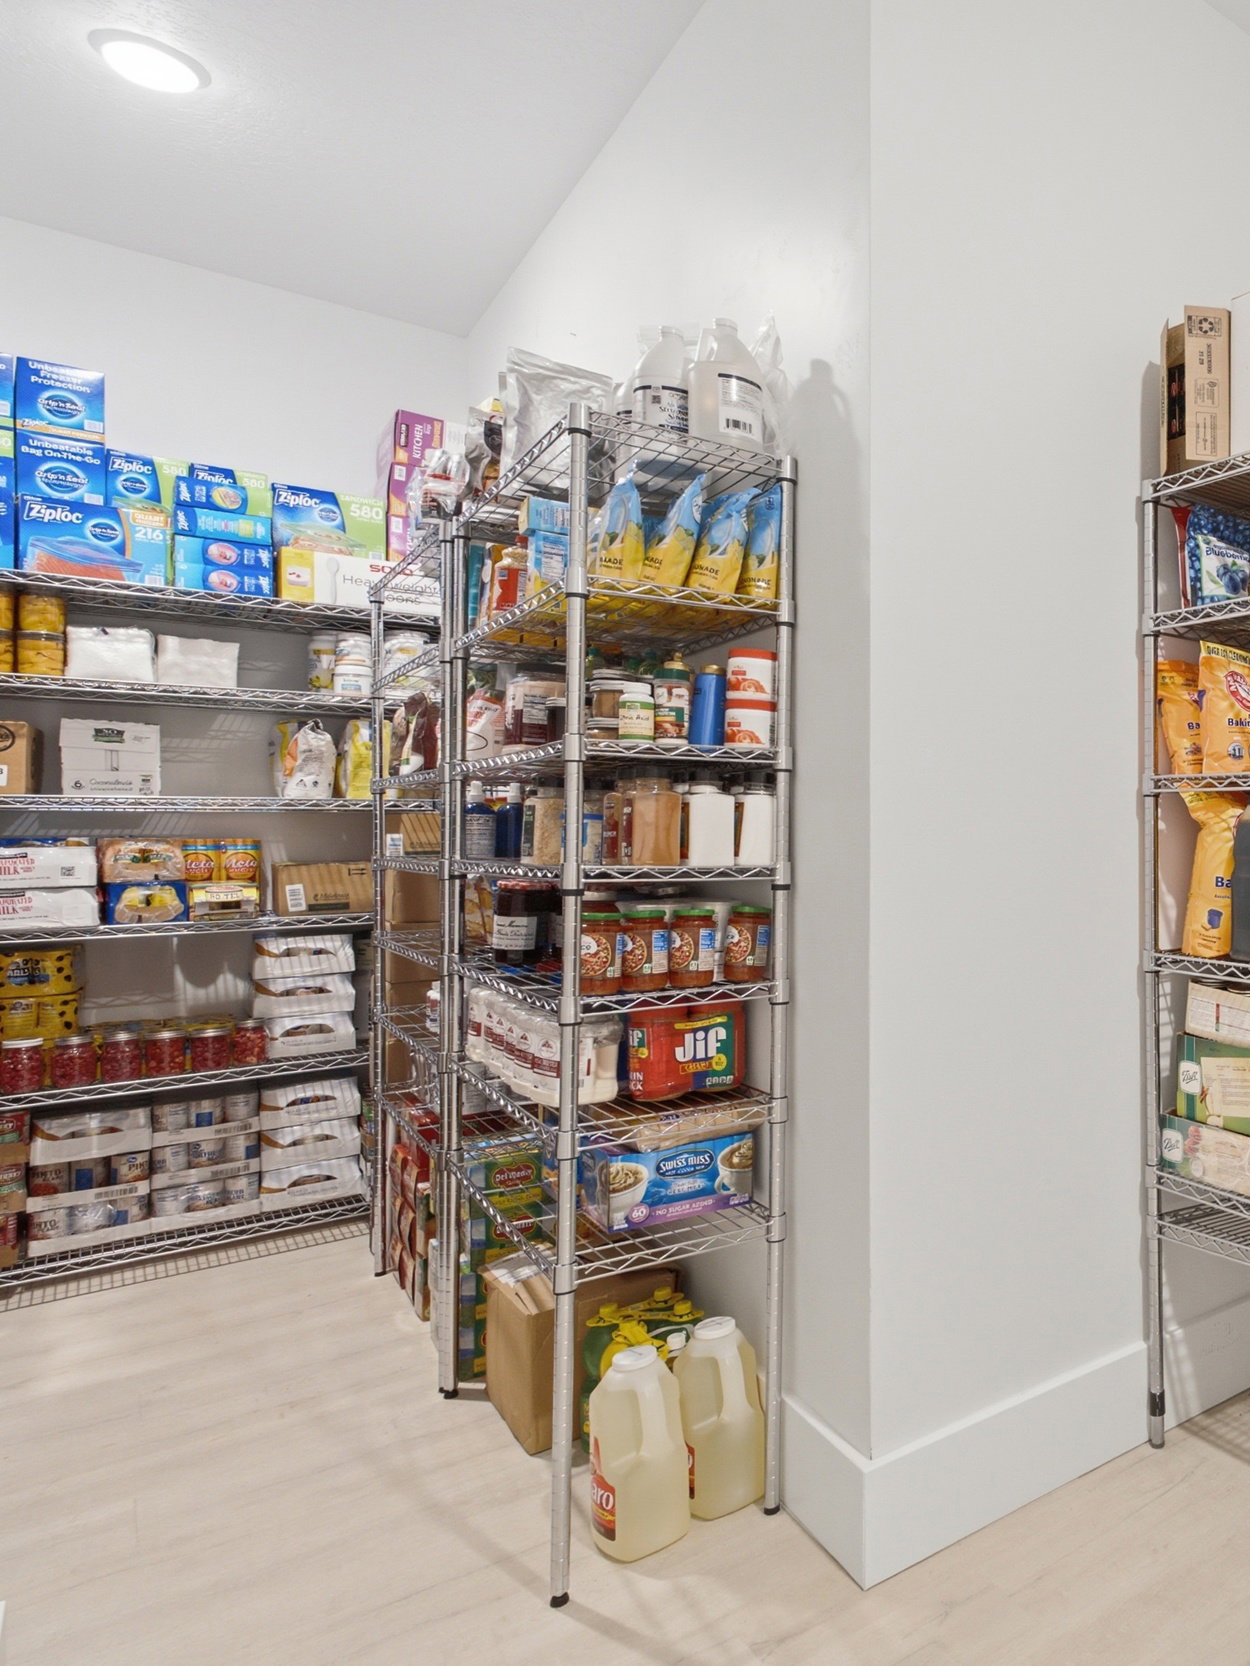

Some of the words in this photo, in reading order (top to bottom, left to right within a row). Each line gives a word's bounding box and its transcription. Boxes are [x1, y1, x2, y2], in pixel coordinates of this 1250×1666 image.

[30, 375, 92, 394] Protection
[28, 438, 94, 456] Unbeatable
[412, 423, 424, 460] KITCHEN
[20, 445, 43, 458] Bag
[111, 458, 153, 474] Ziploc
[162, 465, 188, 477] 580
[242, 477, 266, 489] 580
[277, 490, 321, 509] Ziploc
[29, 503, 84, 524] Ziploc
[349, 503, 384, 521] 580
[134, 527, 164, 541] 216
[674, 1026, 727, 1063] Jif
[658, 1155, 688, 1173] SWISS
[688, 1152, 711, 1166] MISS
[494, 1172, 508, 1182] Del
[632, 1208, 647, 1219] 60
[655, 1208, 667, 1216] NO
[668, 1203, 691, 1213] SUGAR
[692, 1198, 713, 1208] ADDED
